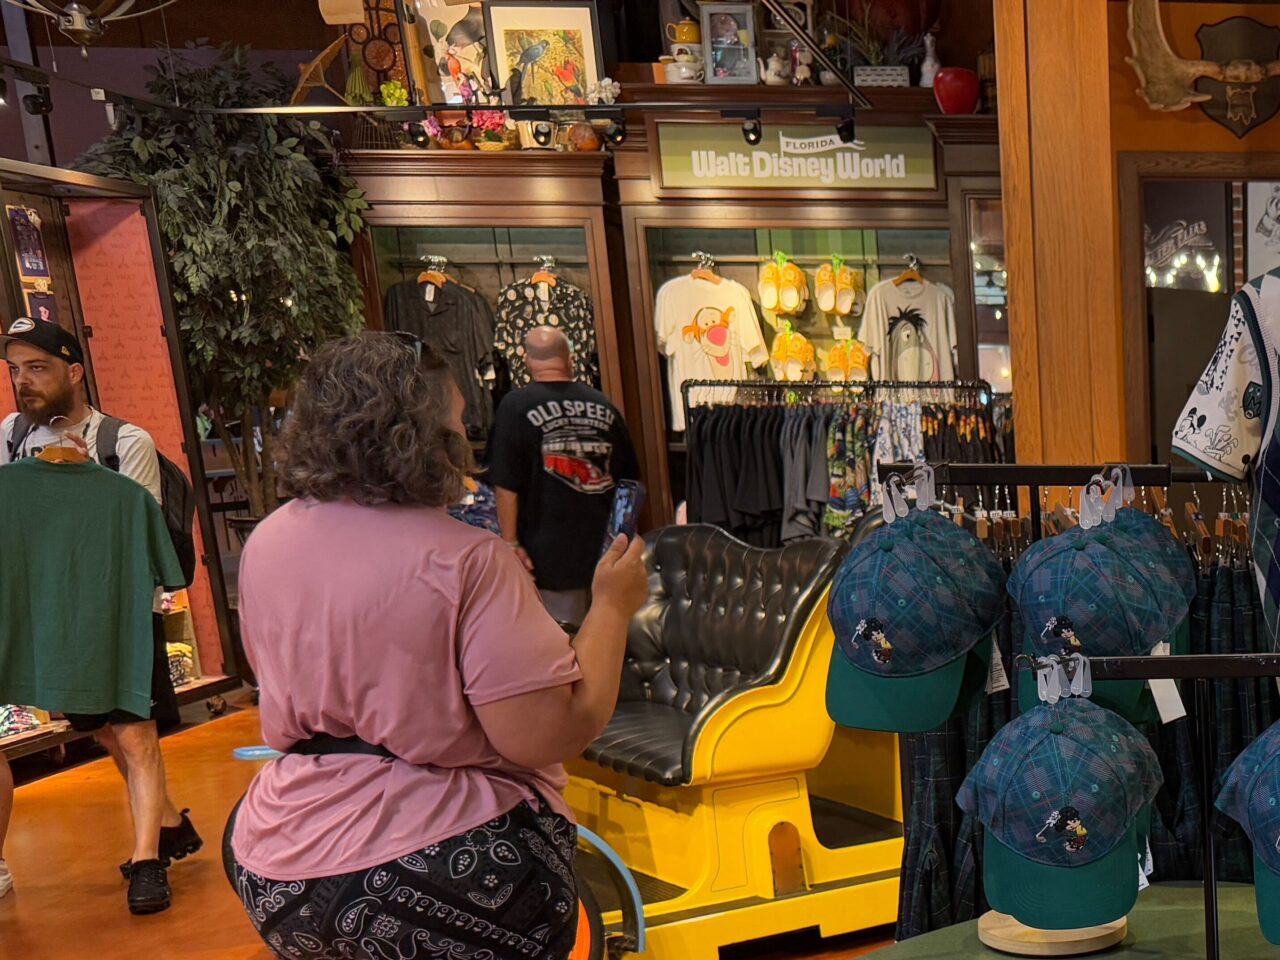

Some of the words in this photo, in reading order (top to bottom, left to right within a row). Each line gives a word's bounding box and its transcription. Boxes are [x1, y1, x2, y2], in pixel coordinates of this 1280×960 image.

[785, 138, 835, 150] FLORIDA
[691, 150, 750, 178] Walt
[752, 151, 835, 184] Disney
[836, 152, 906, 178] World
[526, 401, 563, 427] OLD
